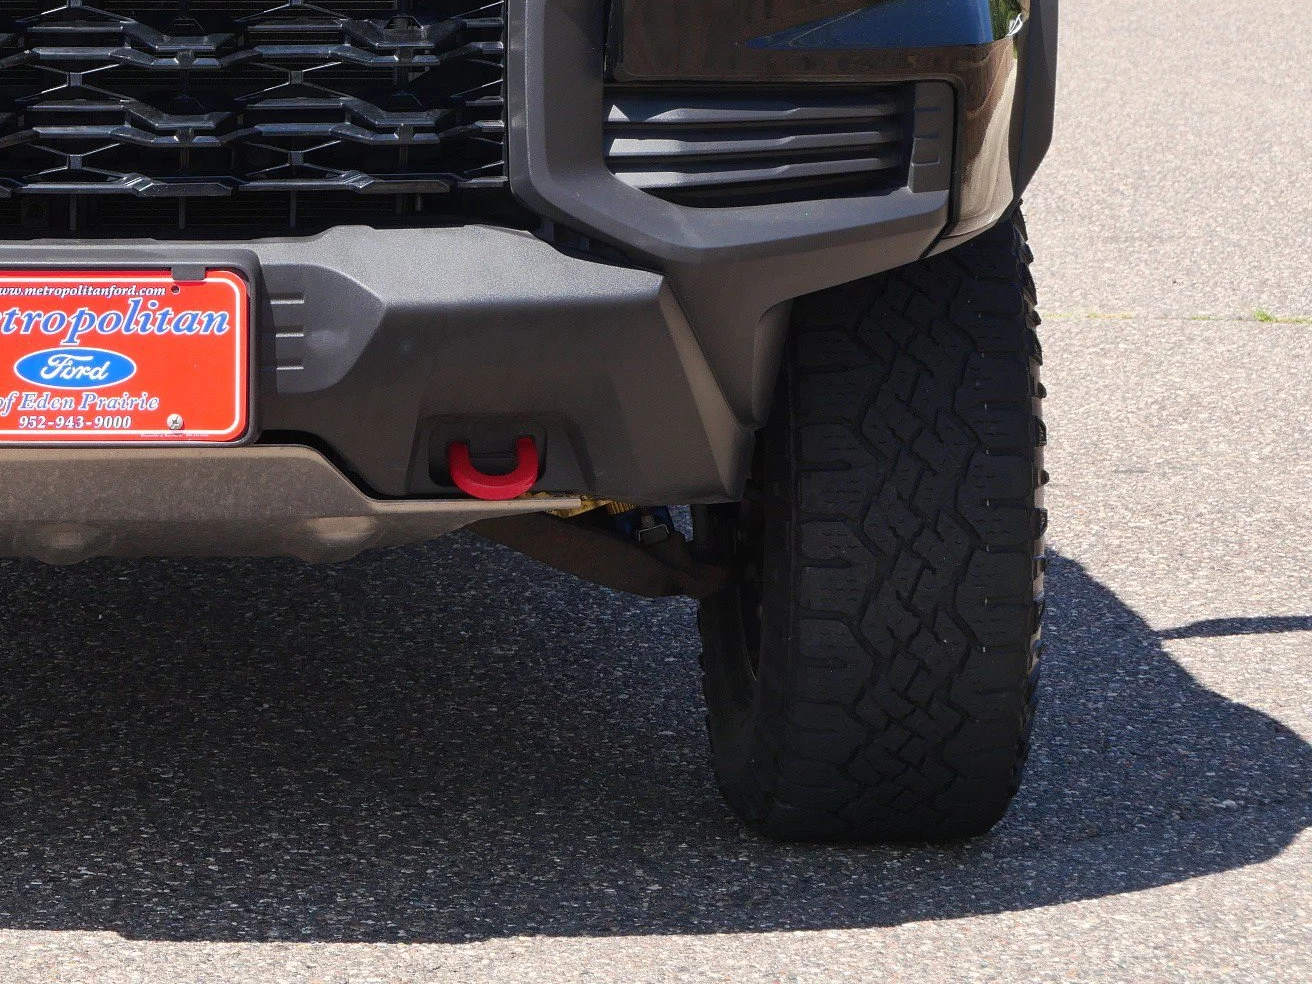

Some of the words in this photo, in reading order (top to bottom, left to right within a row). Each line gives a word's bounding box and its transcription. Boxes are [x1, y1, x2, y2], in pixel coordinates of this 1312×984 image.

[40, 354, 111, 380] Ford
[18, 392, 75, 411] Eden
[78, 392, 160, 411] Prairie
[19, 416, 131, 429] 952-943-9000
